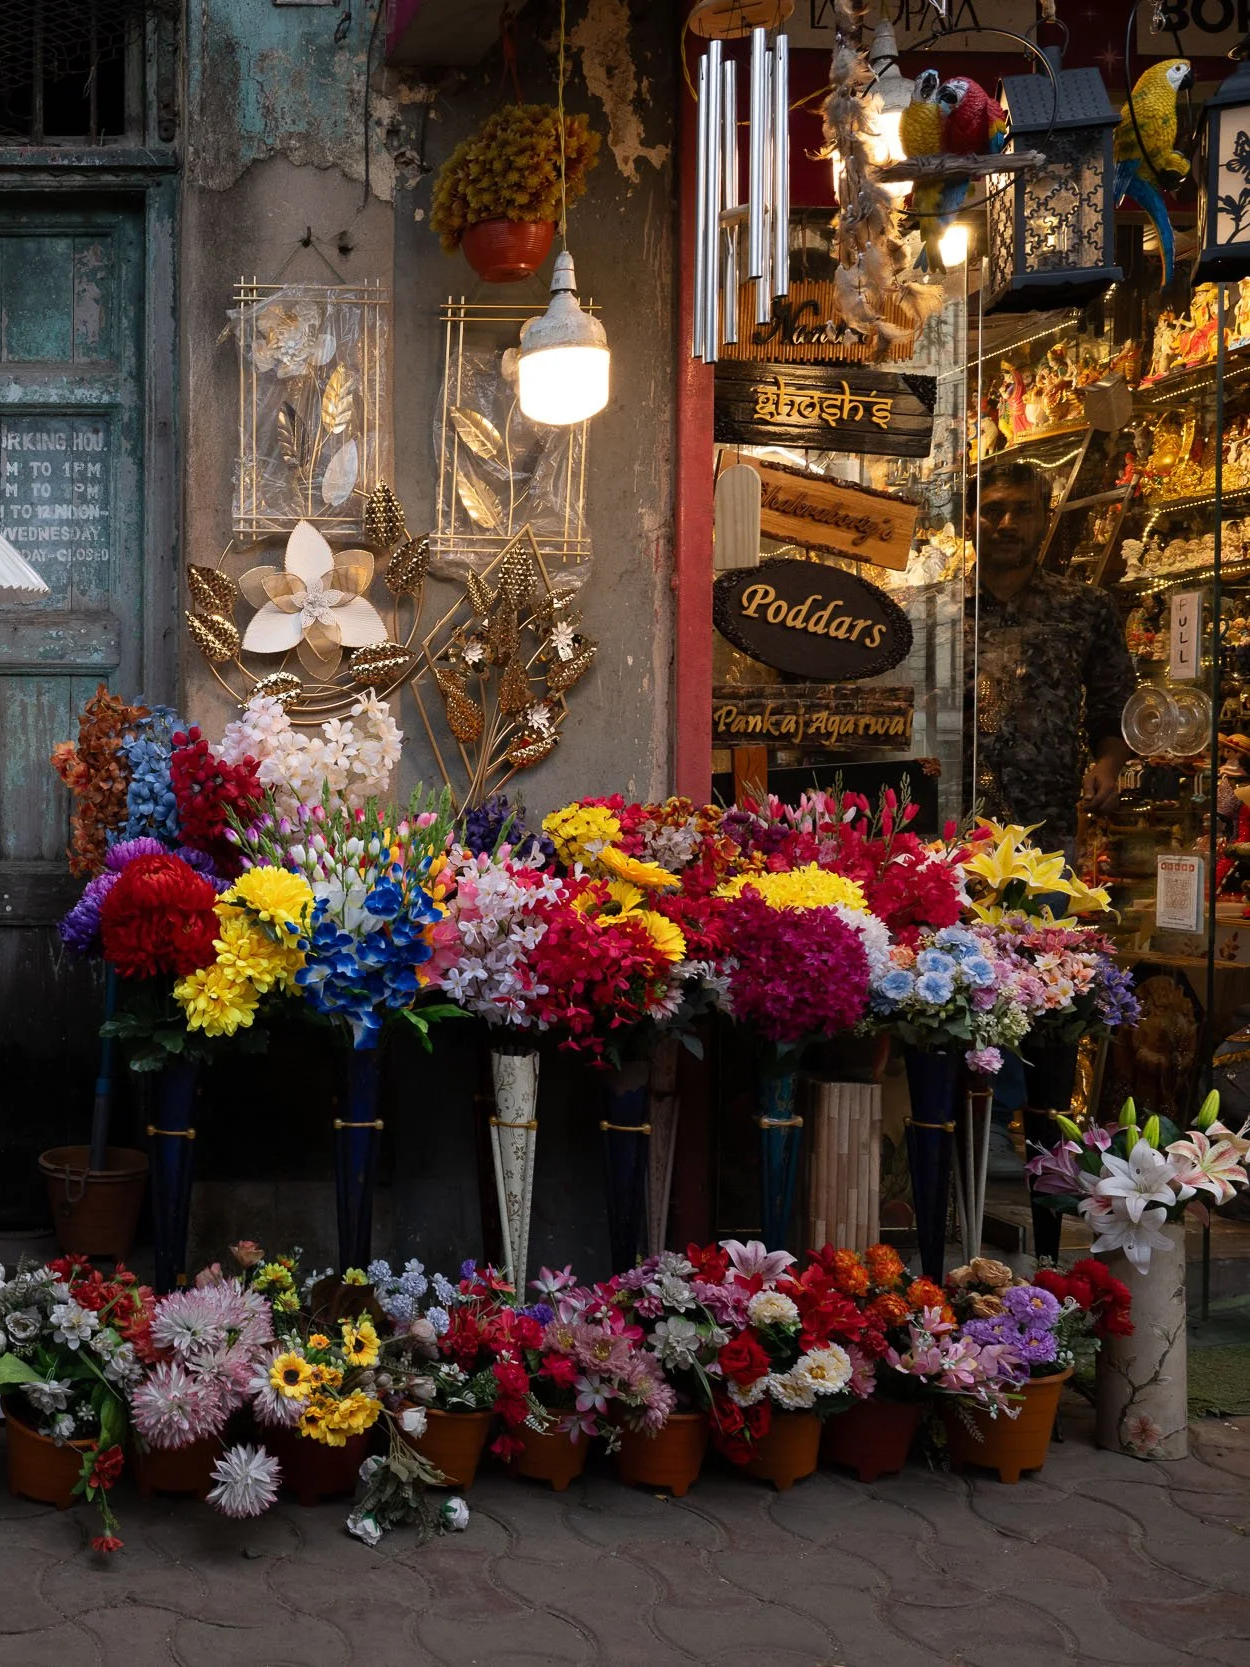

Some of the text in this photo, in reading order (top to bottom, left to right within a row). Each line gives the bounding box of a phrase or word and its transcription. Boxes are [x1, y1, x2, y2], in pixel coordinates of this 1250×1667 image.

[1158, 0, 1250, 33] BO
[30, 462, 52, 478] TO
[31, 483, 52, 498] TO
[10, 505, 32, 519] TO
[741, 584, 887, 648] Poddars
[1178, 599, 1190, 664] PULL
[807, 708, 914, 746] Agarwal
